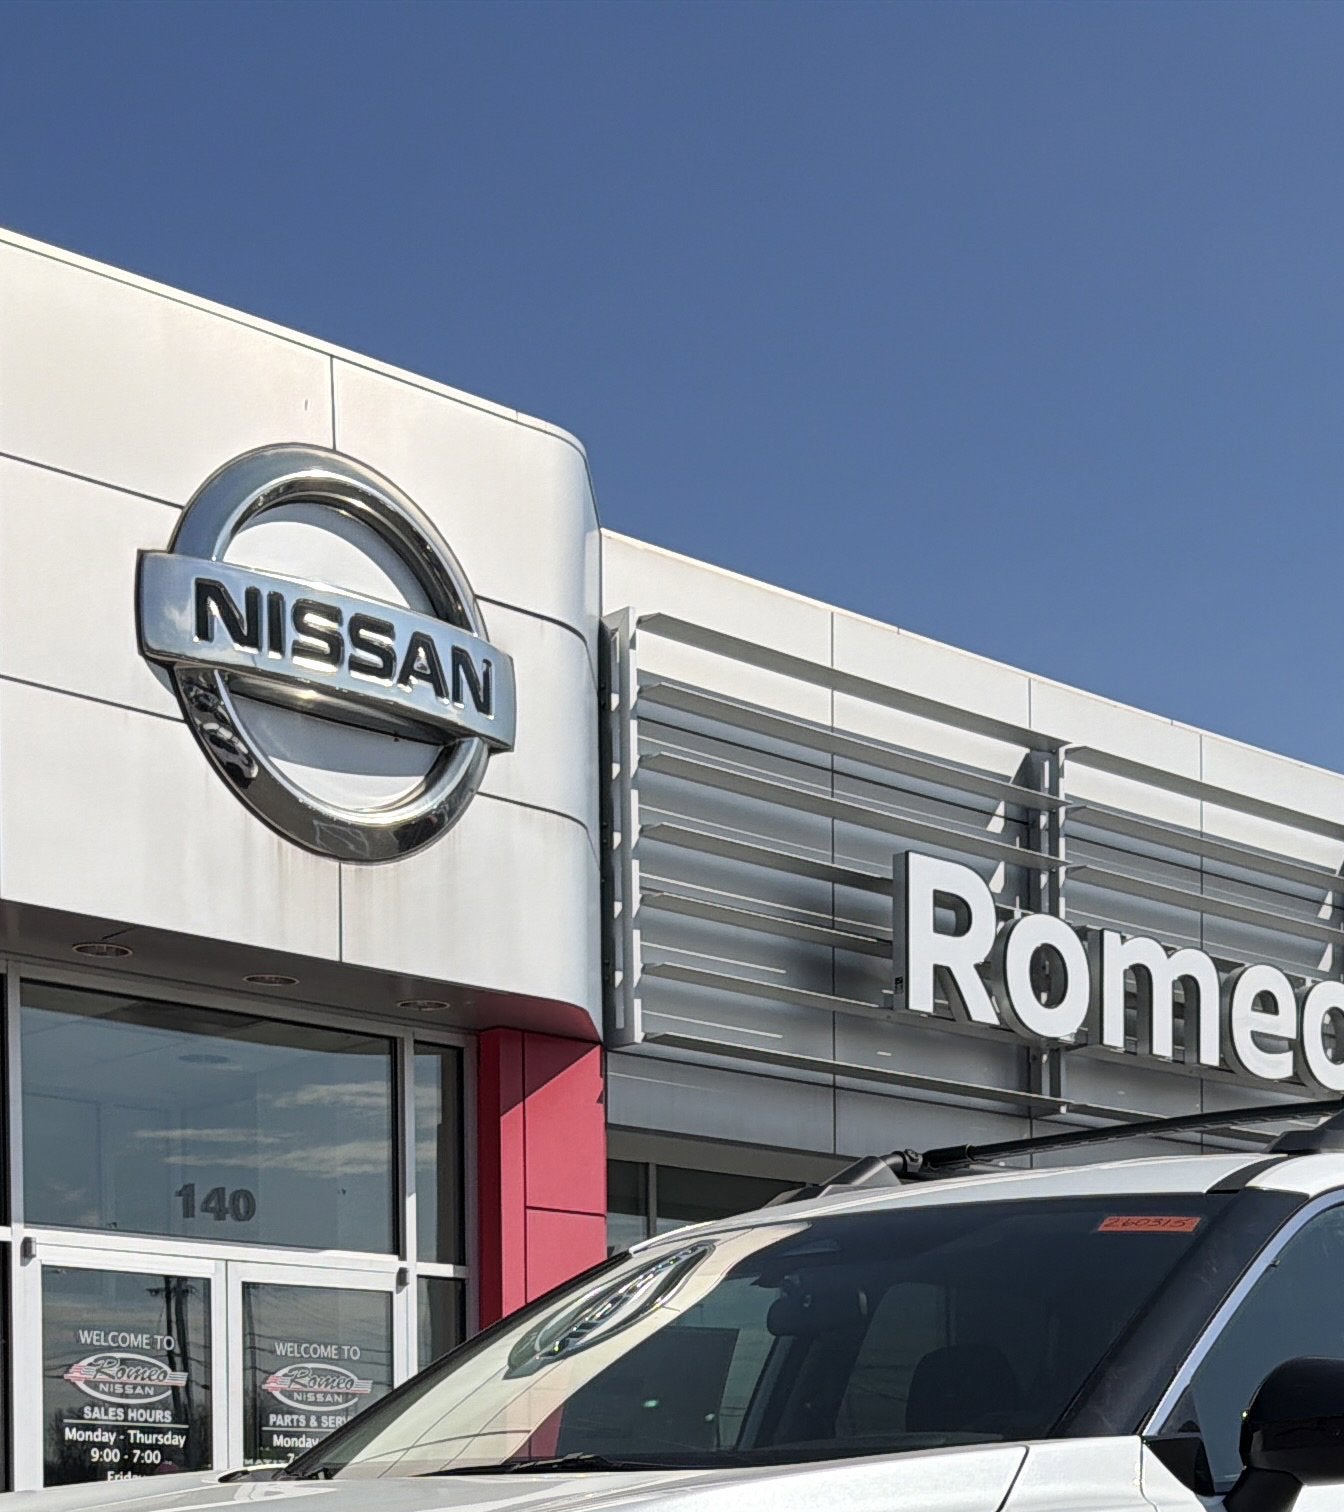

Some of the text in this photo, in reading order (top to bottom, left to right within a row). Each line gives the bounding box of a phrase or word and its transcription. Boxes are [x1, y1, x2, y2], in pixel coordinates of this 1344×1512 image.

[193, 576, 496, 720] NISSAN
[175, 1182, 258, 1222] 140
[78, 1329, 175, 1350] WELCOME TO
[274, 1342, 361, 1360] WELCOME TO
[91, 1355, 169, 1383] Romeo
[287, 1366, 355, 1390] Romeo
[99, 1383, 155, 1396] NISSAN
[293, 1392, 343, 1403] NISSAN
[83, 1406, 172, 1423] SALES HOURS
[269, 1413, 354, 1428] PARTS & SERV
[64, 1427, 117, 1445] Monday
[127, 1430, 187, 1448] Thursday
[90, 1447, 121, 1463] 9:00
[132, 1449, 162, 1464] 7:00
